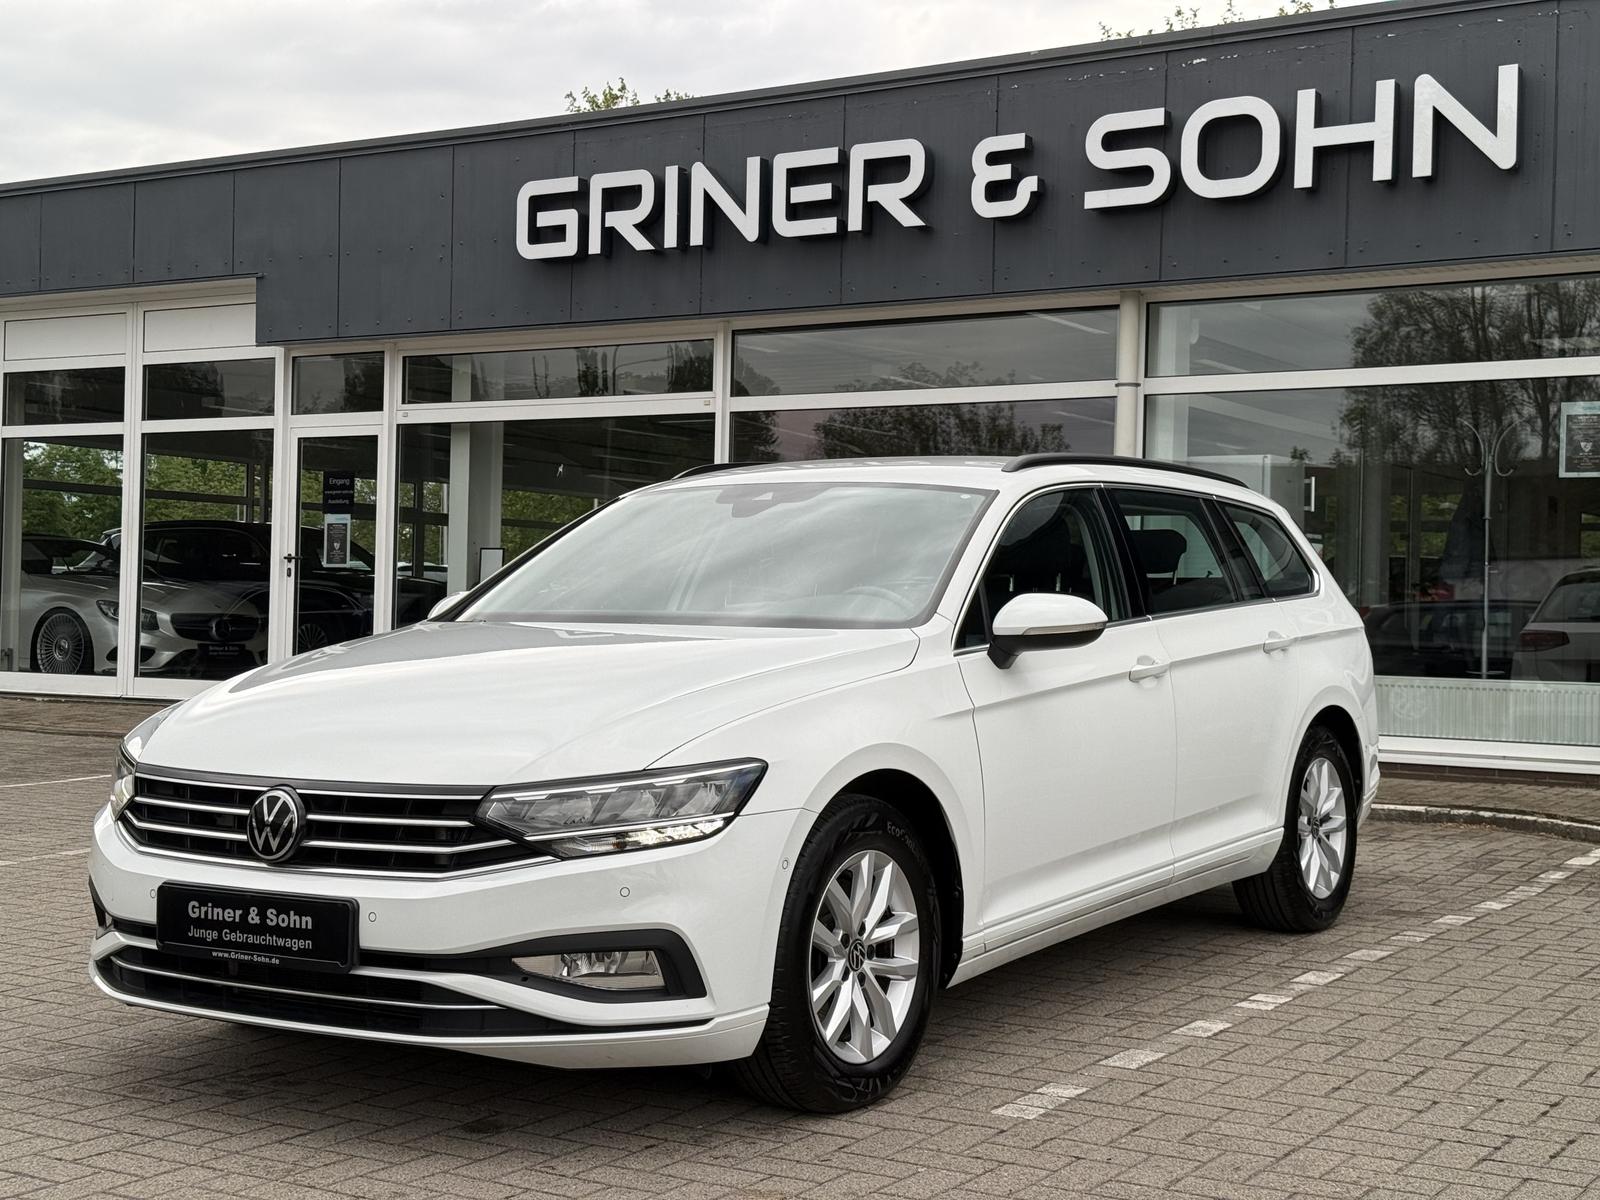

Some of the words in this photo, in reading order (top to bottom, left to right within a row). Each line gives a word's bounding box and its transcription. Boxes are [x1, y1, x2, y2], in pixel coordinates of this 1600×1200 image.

[516, 138, 926, 260] GRINER
[971, 132, 1038, 219] &
[1084, 63, 1519, 210] SOHN
[188, 901, 243, 922] Griner
[247, 906, 260, 924] &
[266, 908, 312, 930] Sohn
[188, 925, 219, 942] Junge
[222, 929, 312, 951] Gebrauchtwagen
[212, 951, 280, 965] www.Griner-Sohn.de
